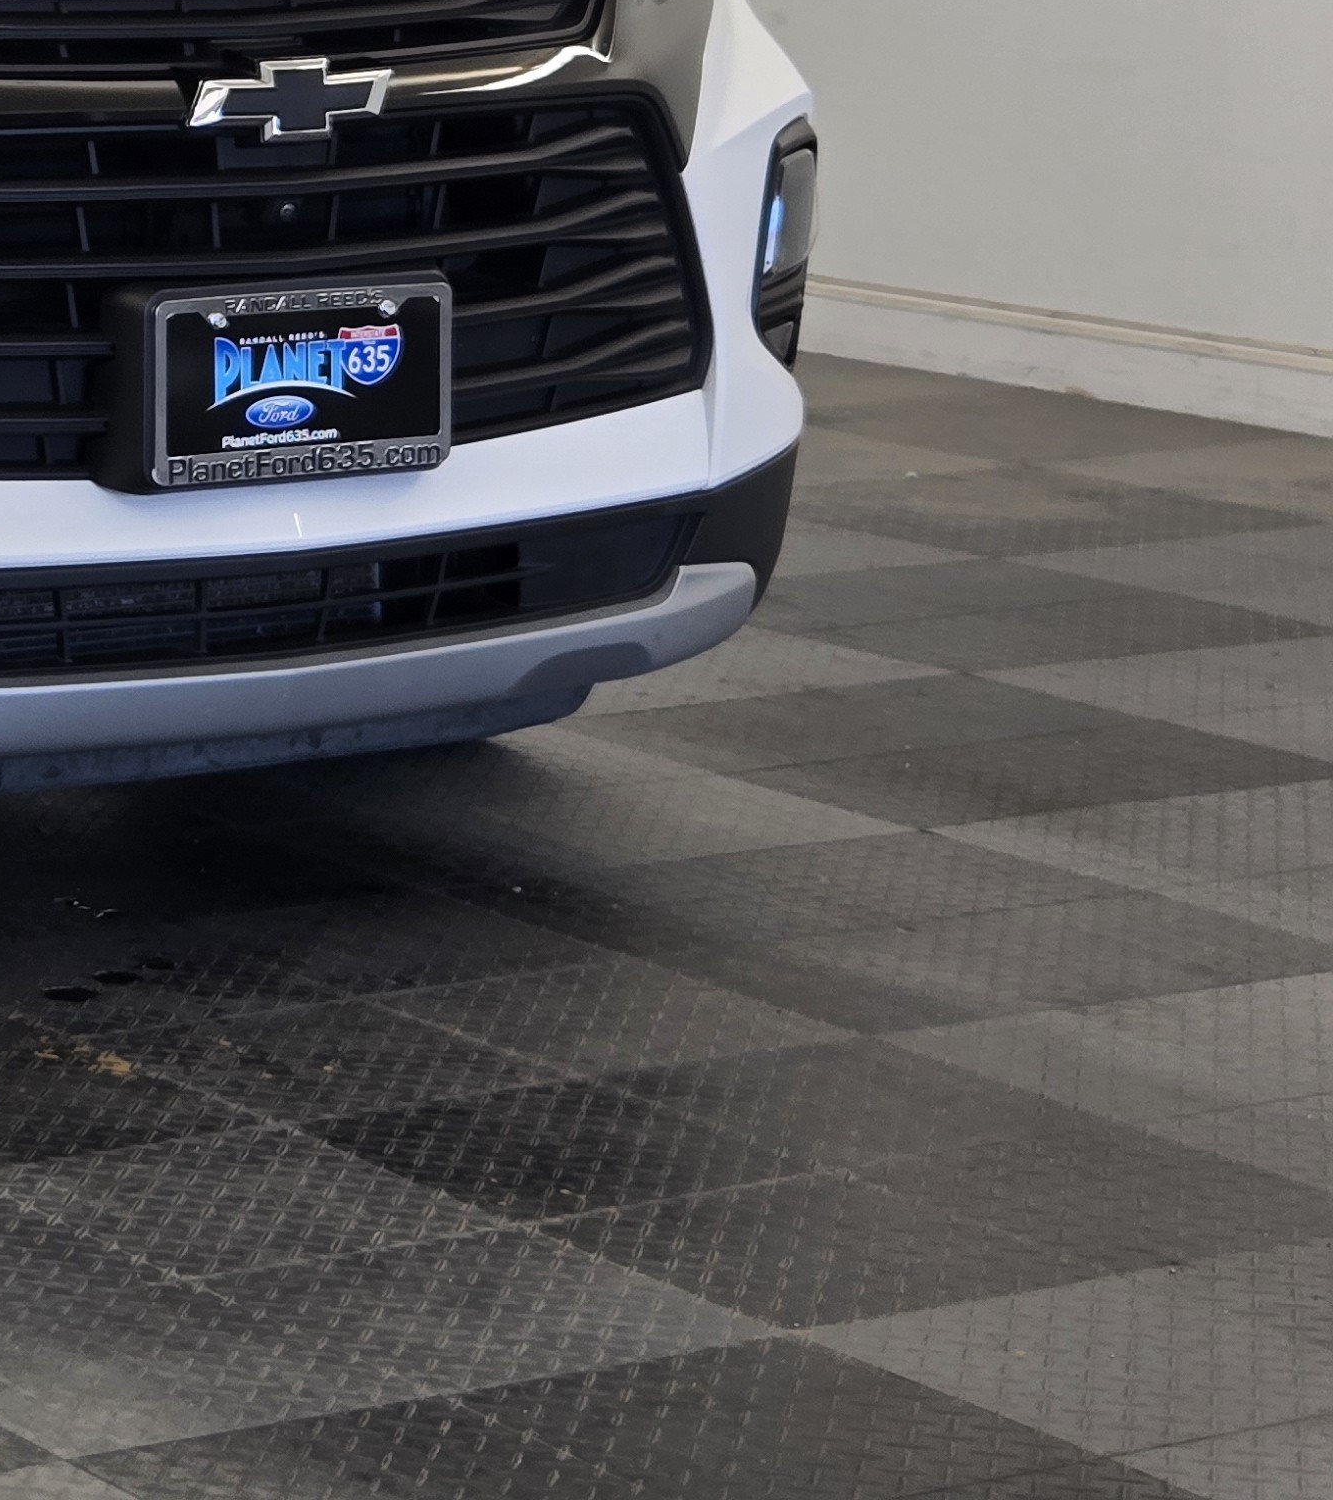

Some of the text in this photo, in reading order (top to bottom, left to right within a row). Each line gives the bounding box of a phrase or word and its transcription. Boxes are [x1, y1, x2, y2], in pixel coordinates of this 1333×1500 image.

[224, 296, 312, 314] RANDALL
[214, 337, 346, 404] PLANET
[348, 345, 390, 374] 635
[259, 404, 301, 422] Ford
[222, 429, 337, 449] PlanetFord635.com
[169, 442, 441, 484] PlanetFord635.com
